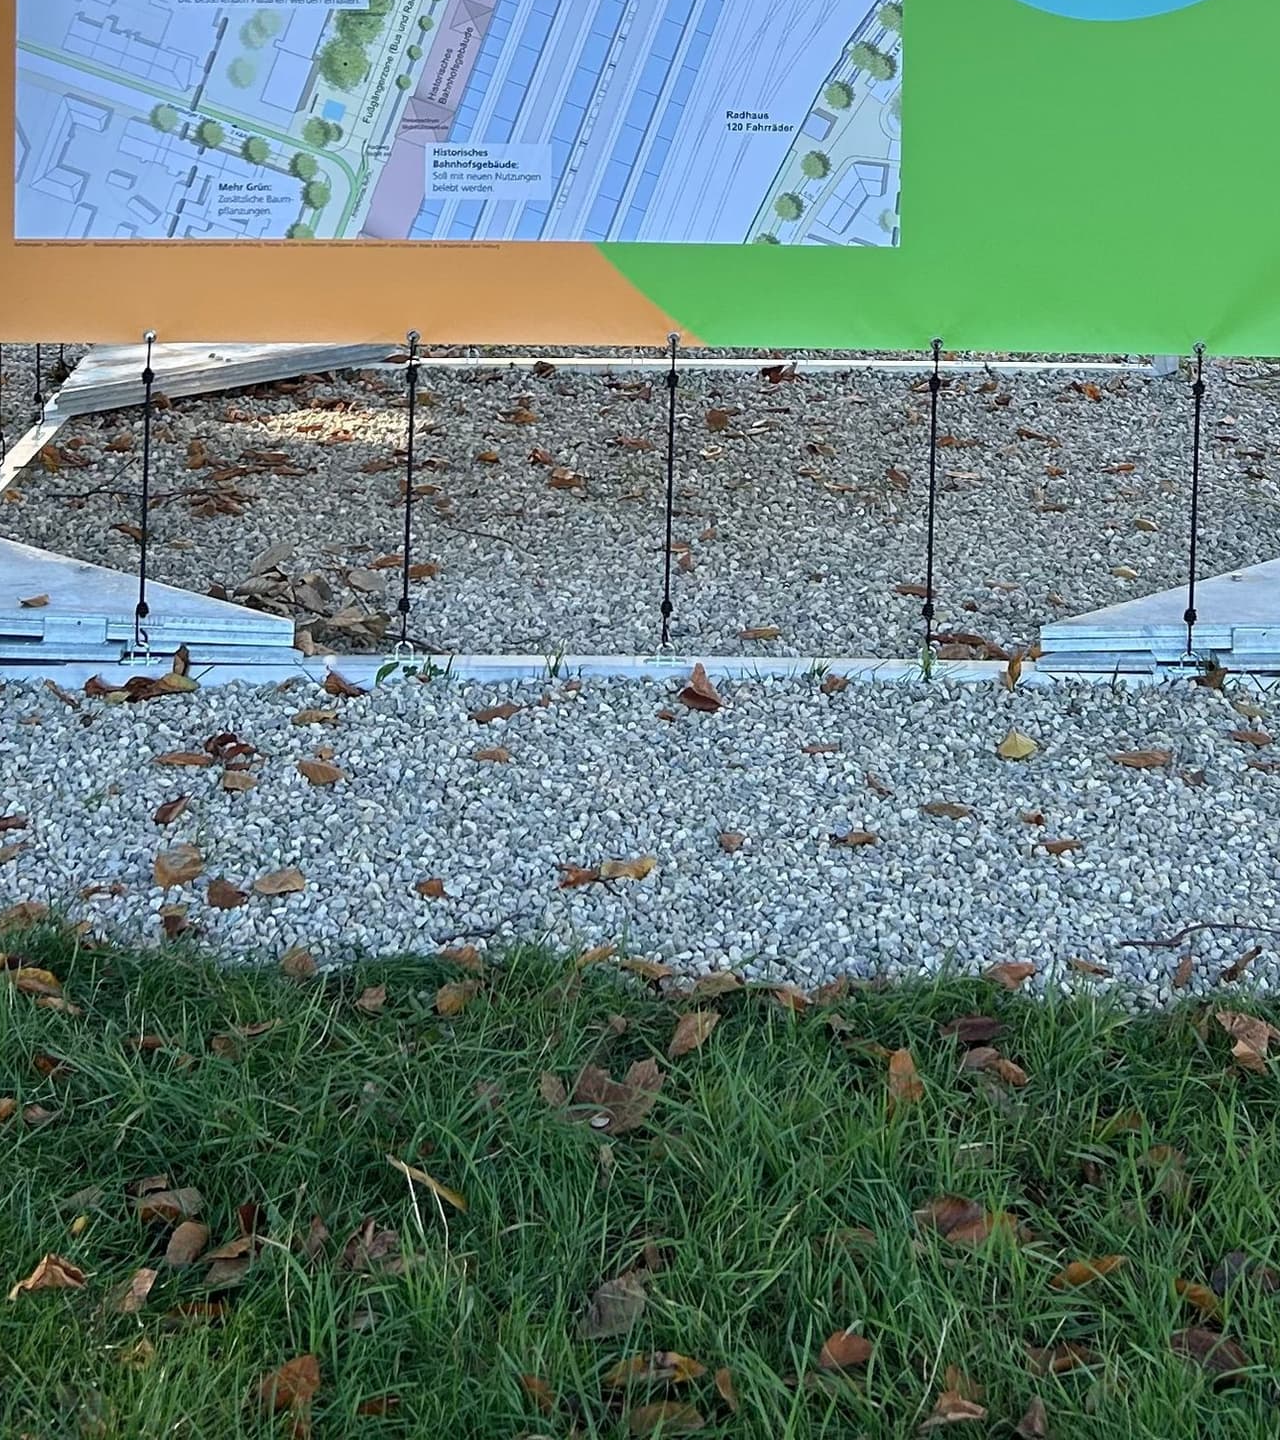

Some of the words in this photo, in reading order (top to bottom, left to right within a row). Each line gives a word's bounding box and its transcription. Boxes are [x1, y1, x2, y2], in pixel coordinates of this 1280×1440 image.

[727, 111, 769, 119] Radhaus
[728, 123, 743, 131] 120
[746, 123, 793, 131] Fahrräder
